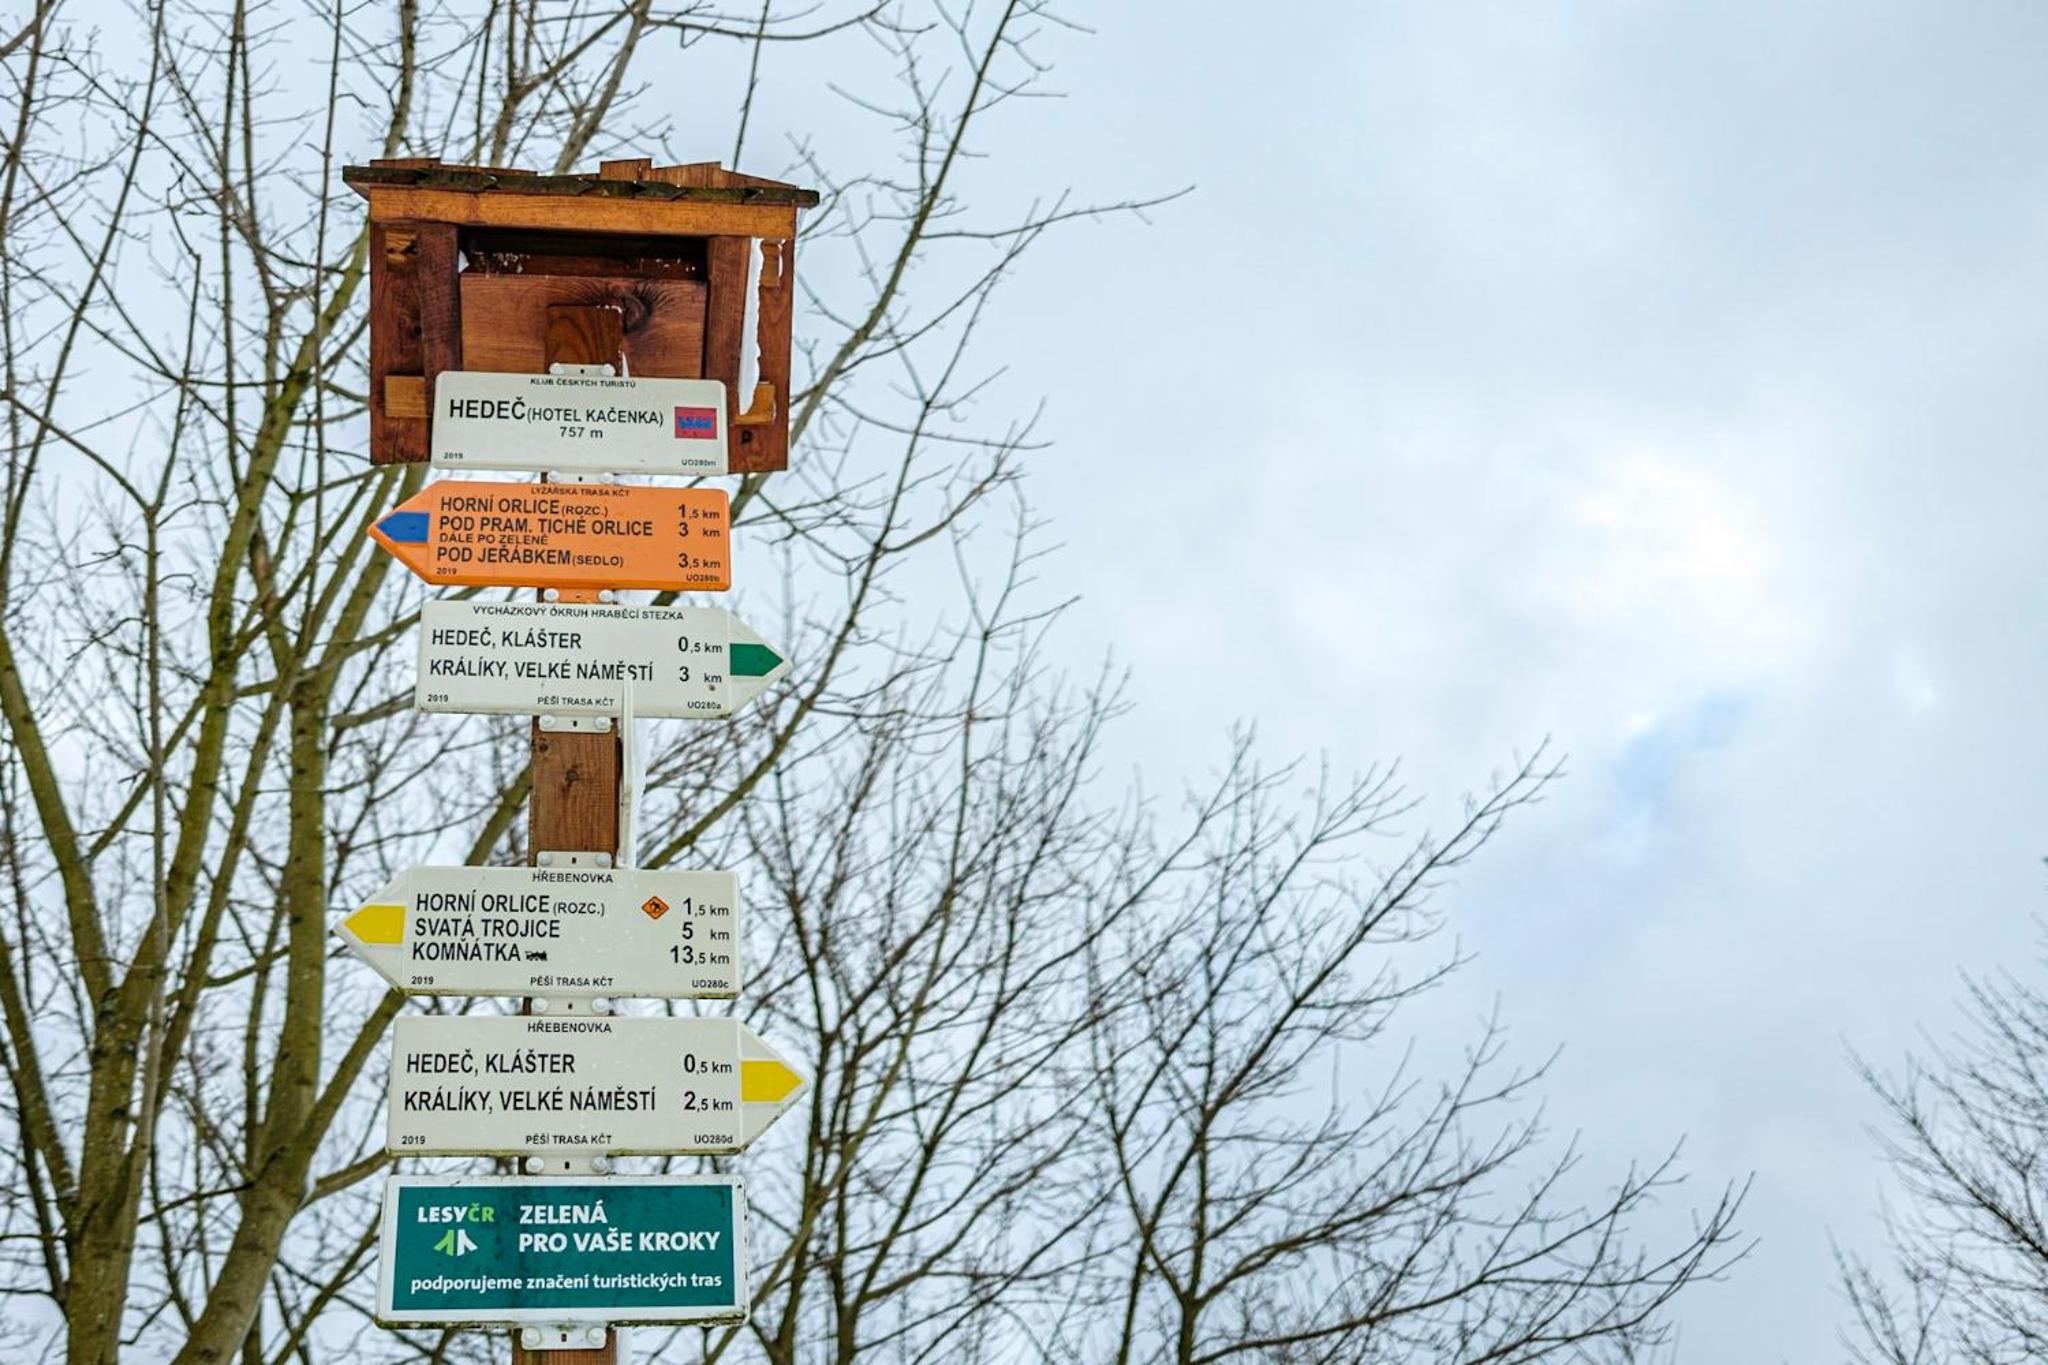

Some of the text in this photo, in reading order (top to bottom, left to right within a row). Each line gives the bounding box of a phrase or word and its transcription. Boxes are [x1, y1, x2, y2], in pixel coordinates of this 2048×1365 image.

[530, 378, 554, 386] KLUB
[449, 396, 664, 427] HEDEČ (HOTEL KAČENKA)
[560, 426, 603, 438] 757 m
[443, 452, 464, 460] 2019
[580, 488, 611, 497] TRASA
[441, 493, 720, 520] HORNÍ ORLICE (ROZC.) 1,5 km
[439, 517, 720, 538] POD PRAM. TICHÉ ORLICE 3 km
[439, 531, 548, 545] DÁLE PO ZELENÉ
[437, 545, 721, 569] POD JEŘÁBKEM (SEDLO) 3,5 km
[436, 567, 457, 575] 2019
[472, 605, 547, 618] VYCHÁZKOVÝ
[642, 610, 684, 621] STEZKA
[432, 626, 722, 654] HEDEČ, KLÁŠTER 0,5 km
[429, 656, 722, 683] KRÁLÍKY, VELKÉ NÁMĚSTÍ 3 km
[427, 694, 449, 703] 2019
[561, 696, 595, 706] TRASA
[595, 697, 615, 707] KČT
[532, 870, 613, 884] HŘEBENOVKA
[416, 889, 729, 917] HORNÍ ORLICE (ROZC.) 1,5 km
[415, 912, 730, 941] SVATÁ TROJICE 5 km
[412, 937, 730, 965] KOMŇÁTKA 13,5 km
[411, 975, 729, 989] 2019 PĚŠÍ TRASA KČT UO280c
[527, 1020, 612, 1033] HŘEBENOVKA
[406, 1048, 732, 1076] HEDEČ, KLÁŠTER 0,5 km
[404, 1085, 733, 1114] KRÁLÍKY, VELKÉ NÁMĚSTÍ 2,5 km
[401, 1133, 733, 1145] 2019 PĚŠÍ TRASA KČT UO280d
[519, 1200, 608, 1225] ZELENÁ
[519, 1227, 720, 1252] PRO VAŠE KROKY
[411, 1272, 722, 1295] podporujeme značení turistických tras
